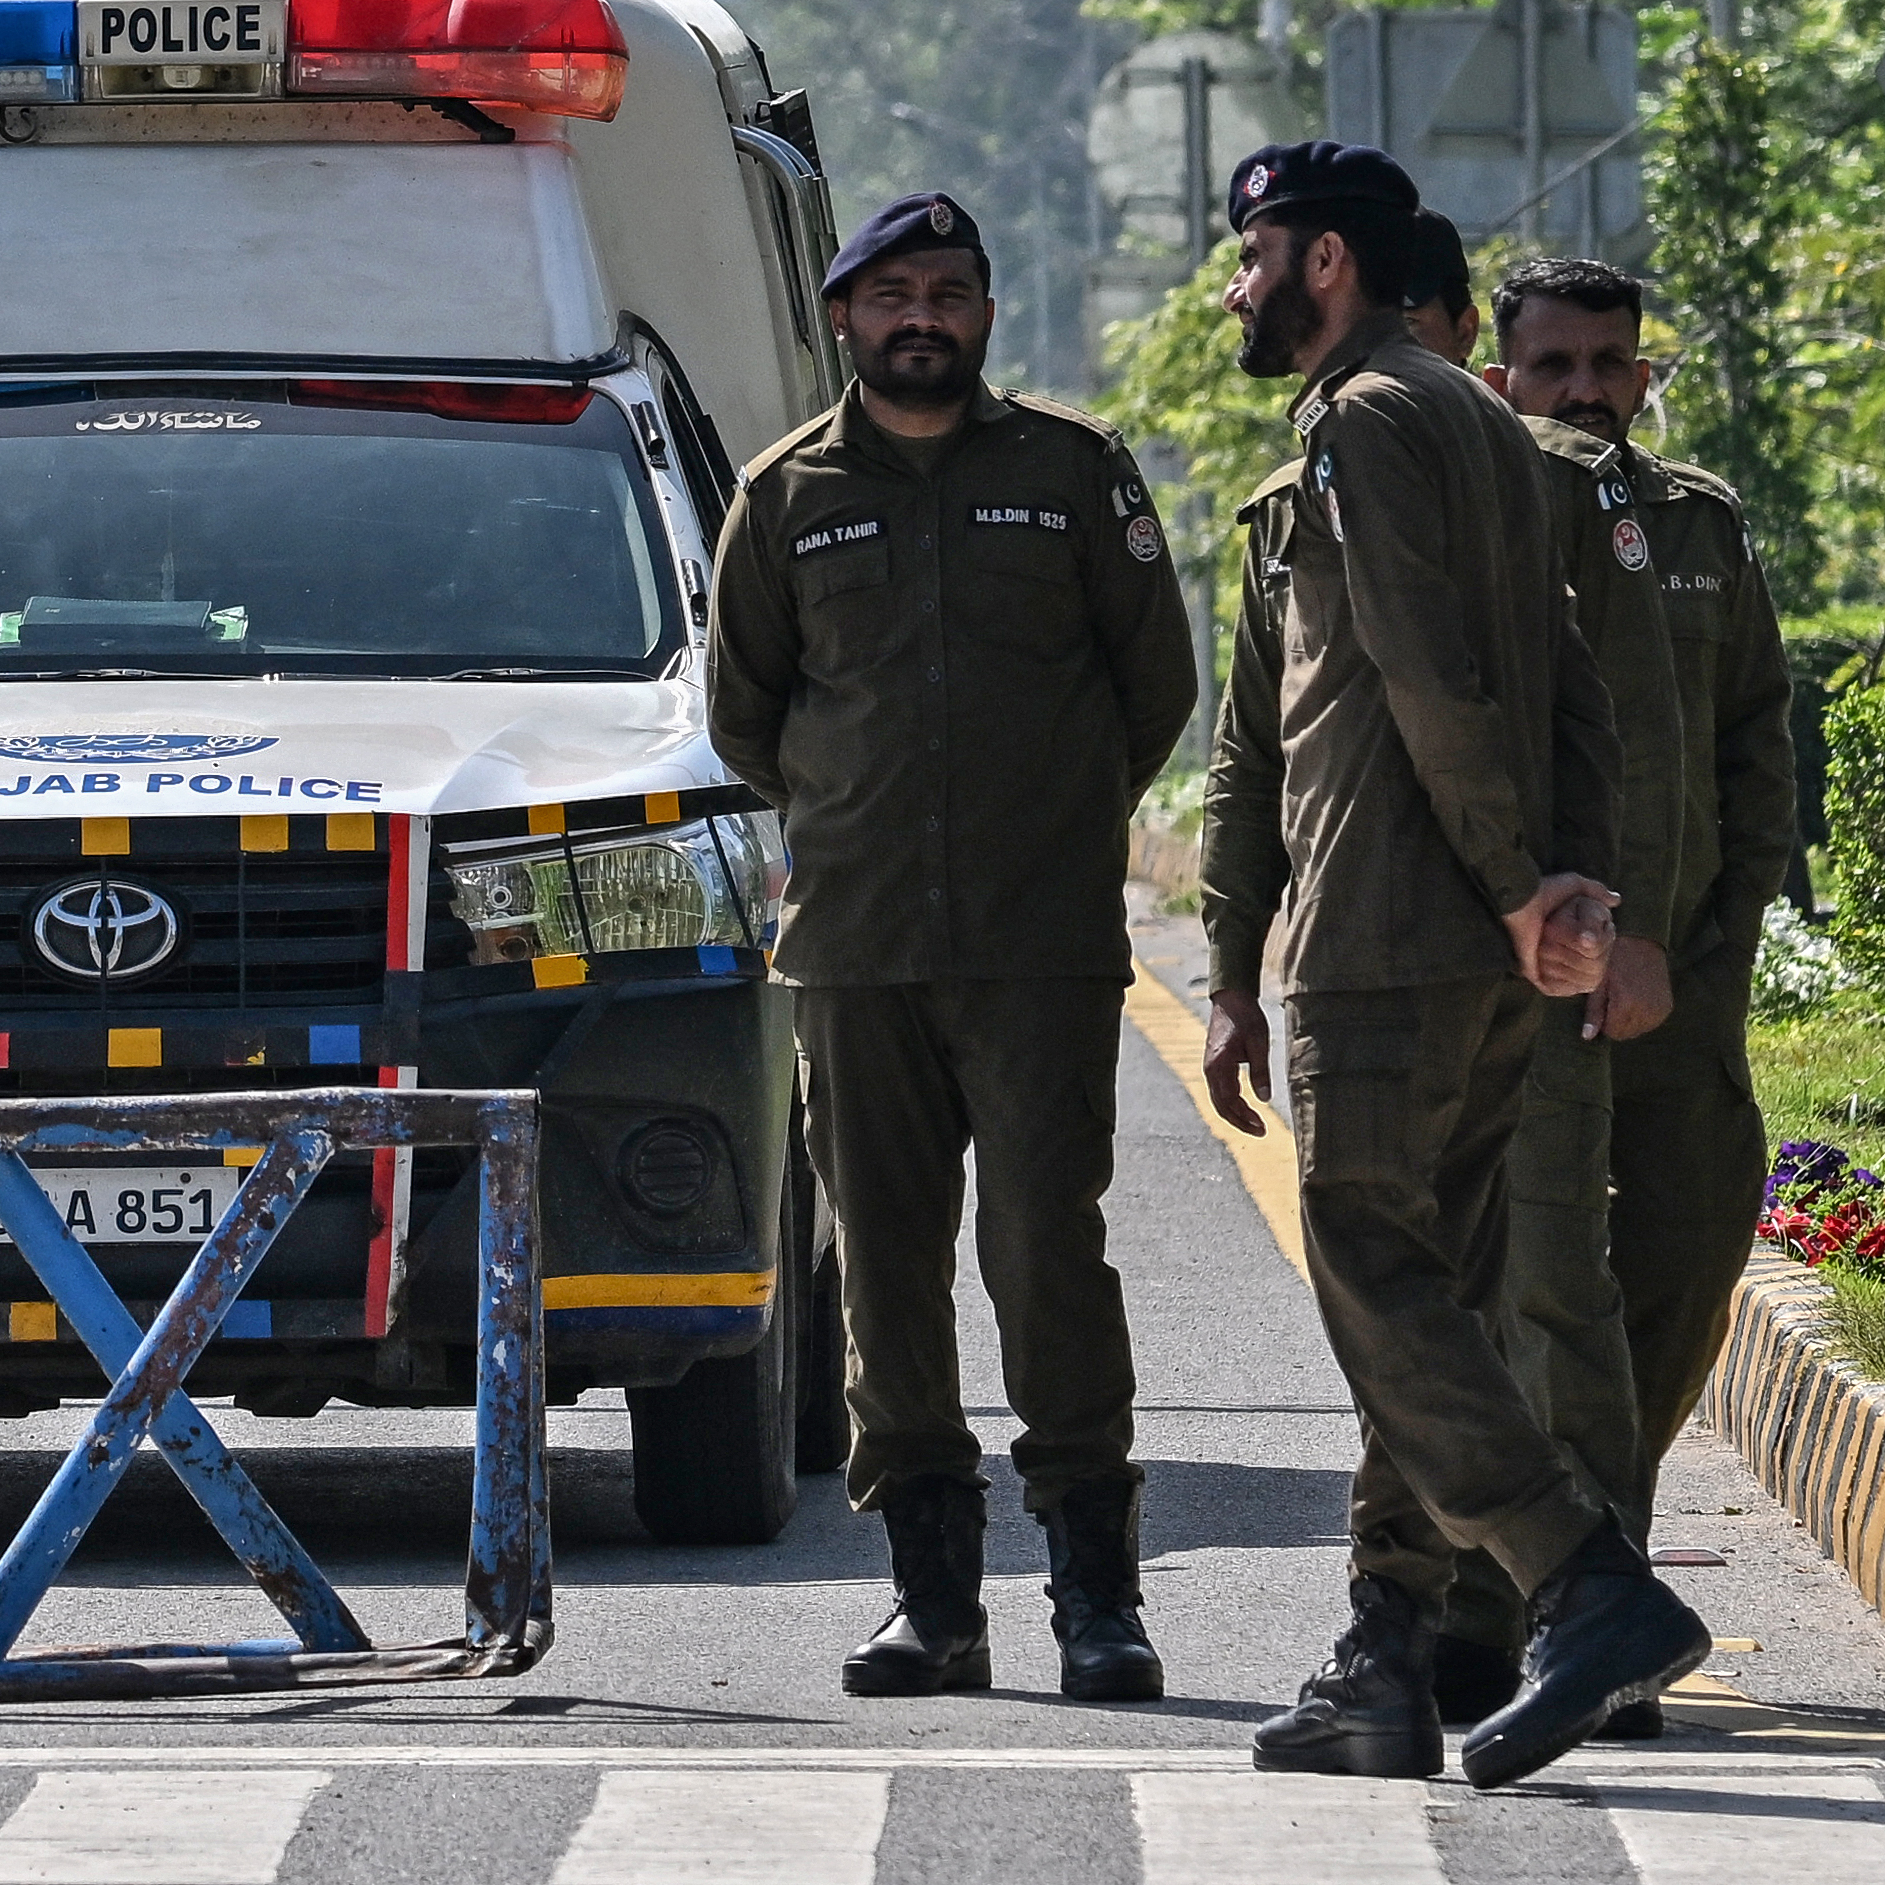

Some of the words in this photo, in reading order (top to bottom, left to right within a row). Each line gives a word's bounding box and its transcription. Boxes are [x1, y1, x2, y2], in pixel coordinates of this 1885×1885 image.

[101, 5, 261, 54] POLICE
[796, 531, 832, 555] RANA
[834, 521, 878, 542] TAHIR
[145, 772, 383, 803] POLICE
[115, 1188, 217, 1235] 851
